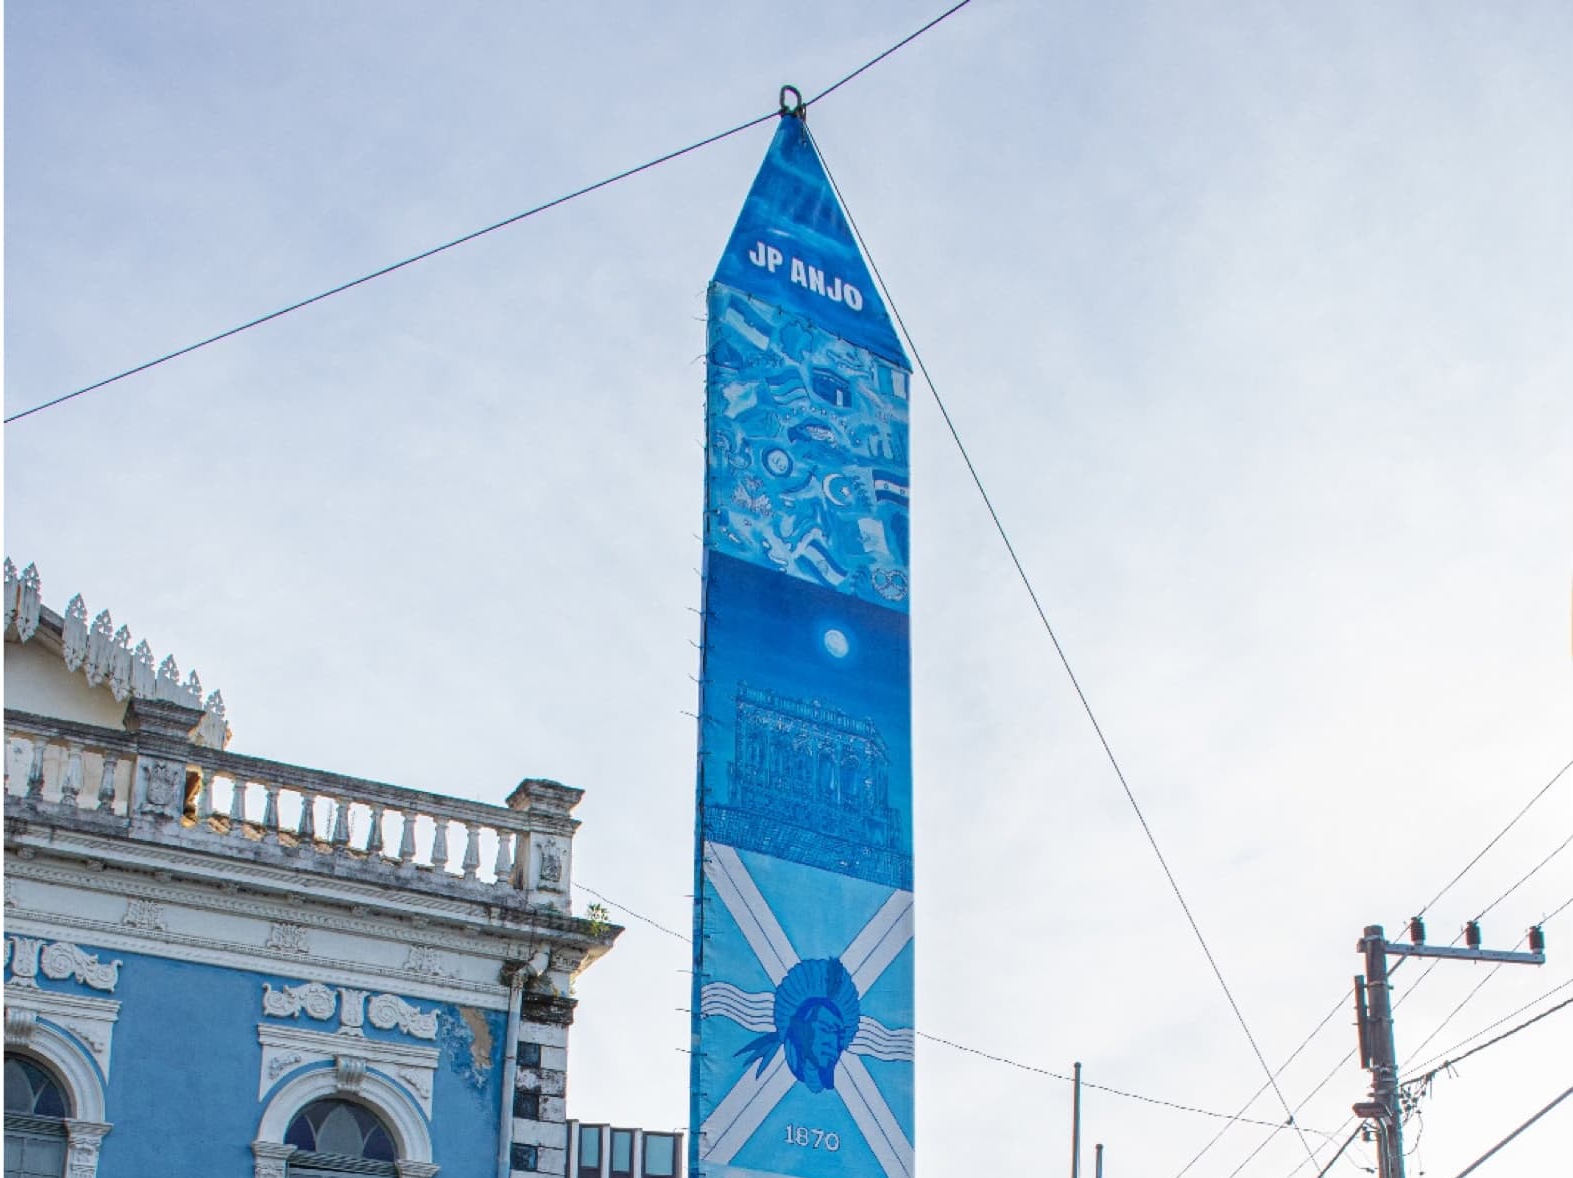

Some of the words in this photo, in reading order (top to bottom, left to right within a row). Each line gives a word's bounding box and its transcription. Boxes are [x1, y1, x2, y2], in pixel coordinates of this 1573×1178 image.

[749, 241, 783, 273] JP
[790, 257, 863, 312] ANJO
[785, 1124, 840, 1152] 1870
